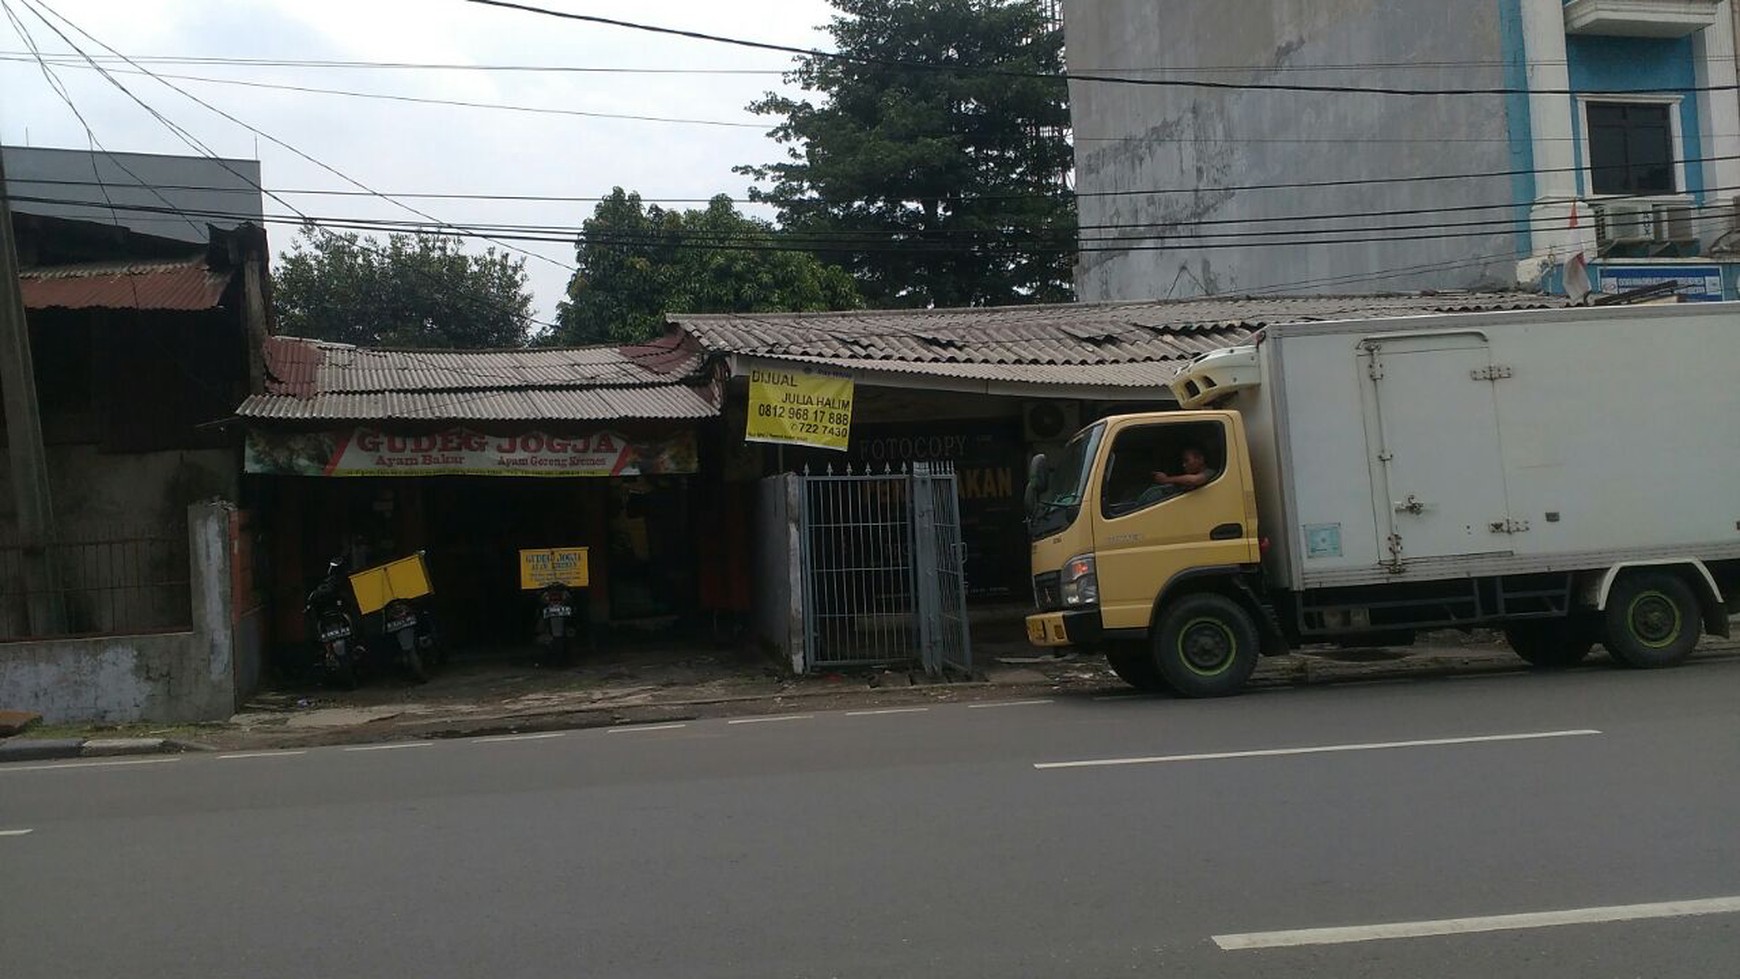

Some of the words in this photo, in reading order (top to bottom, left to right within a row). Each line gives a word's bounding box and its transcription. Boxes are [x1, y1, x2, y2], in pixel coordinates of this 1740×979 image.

[752, 369, 799, 387] DIJUAL
[782, 392, 813, 407] JULIA
[816, 397, 850, 411] HALIM
[758, 403, 785, 418] 0812
[788, 407, 809, 421] 968
[813, 410, 826, 423] 17
[828, 413, 849, 427] 888
[799, 422, 819, 434] 722
[822, 425, 848, 438] 7430
[356, 430, 488, 453] GUDEG
[496, 430, 617, 453] JOGJA
[859, 434, 969, 461] FOTOCOPY
[375, 455, 418, 467] Ayam
[422, 454, 466, 466] Bakar
[498, 456, 528, 467] Ayam
[530, 456, 568, 468] Goreng
